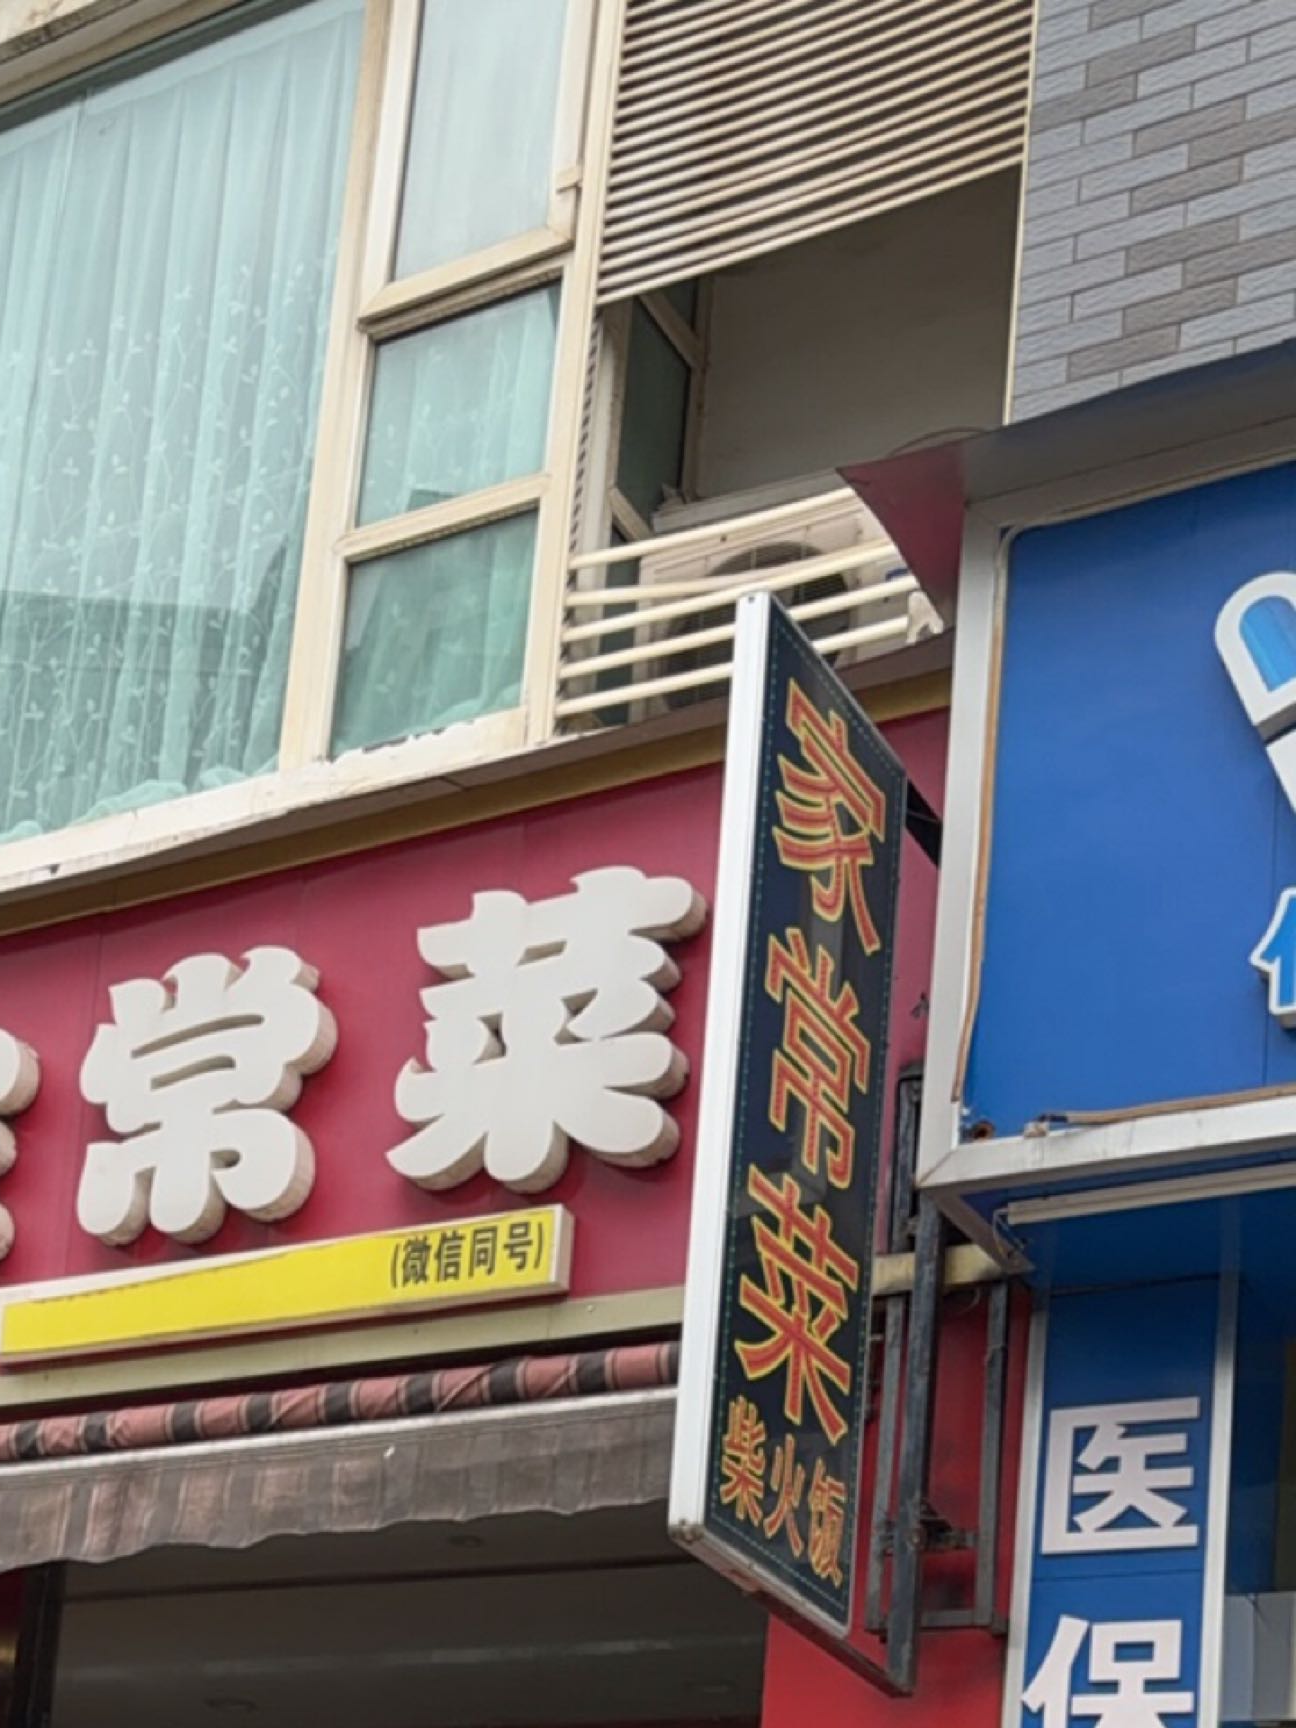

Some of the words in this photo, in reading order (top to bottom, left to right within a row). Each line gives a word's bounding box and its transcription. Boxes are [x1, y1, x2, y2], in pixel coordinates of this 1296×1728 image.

[391, 1222, 543, 1289] (微信同号)
[735, 676, 887, 1446] 家常菜
